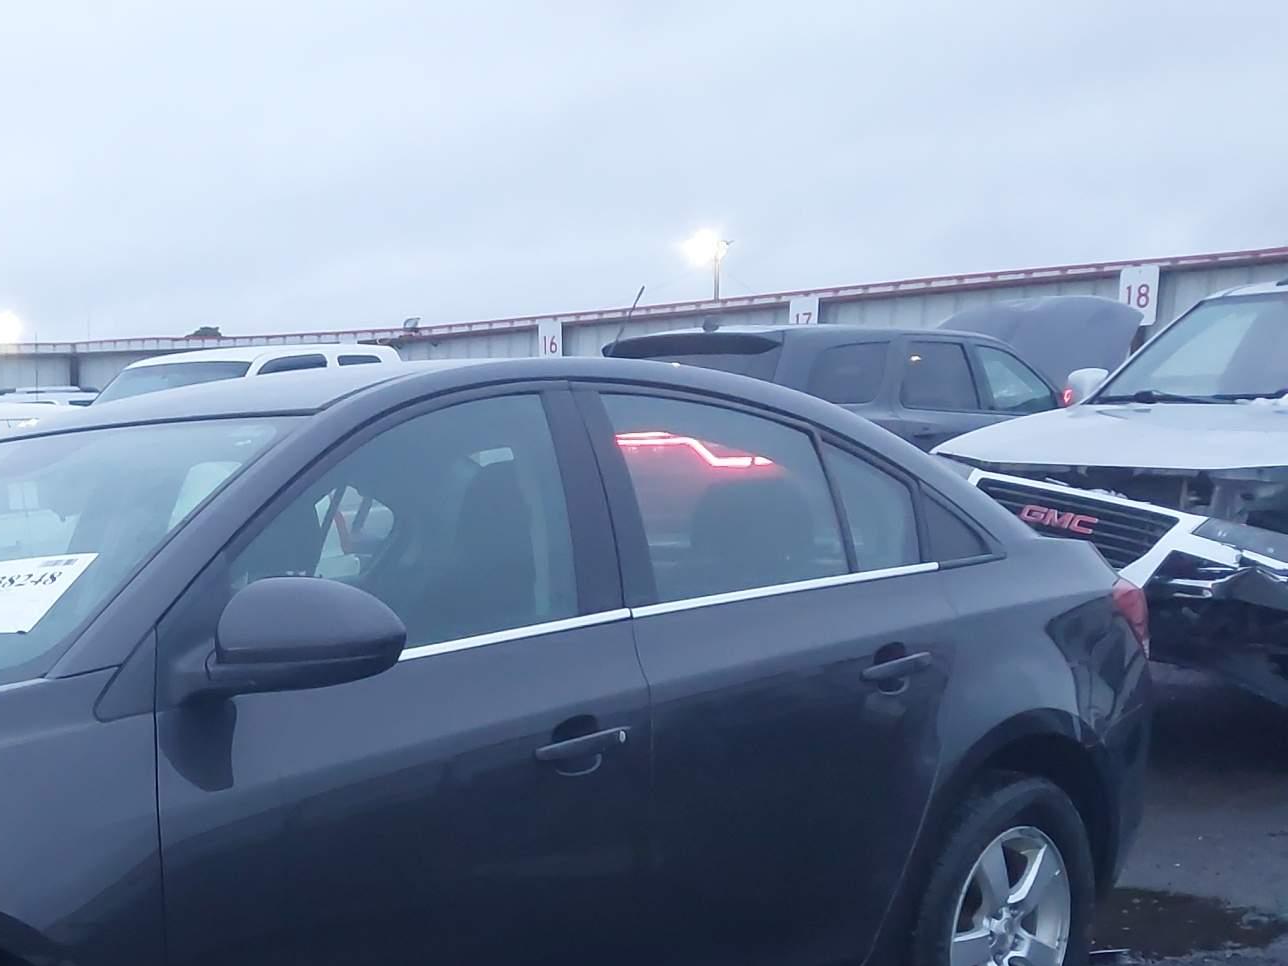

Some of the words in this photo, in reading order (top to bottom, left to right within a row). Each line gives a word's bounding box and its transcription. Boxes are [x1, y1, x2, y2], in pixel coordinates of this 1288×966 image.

[1126, 284, 1150, 308] 18
[795, 312, 812, 325] 17
[543, 335, 558, 355] 16
[1019, 503, 1099, 535] GMC
